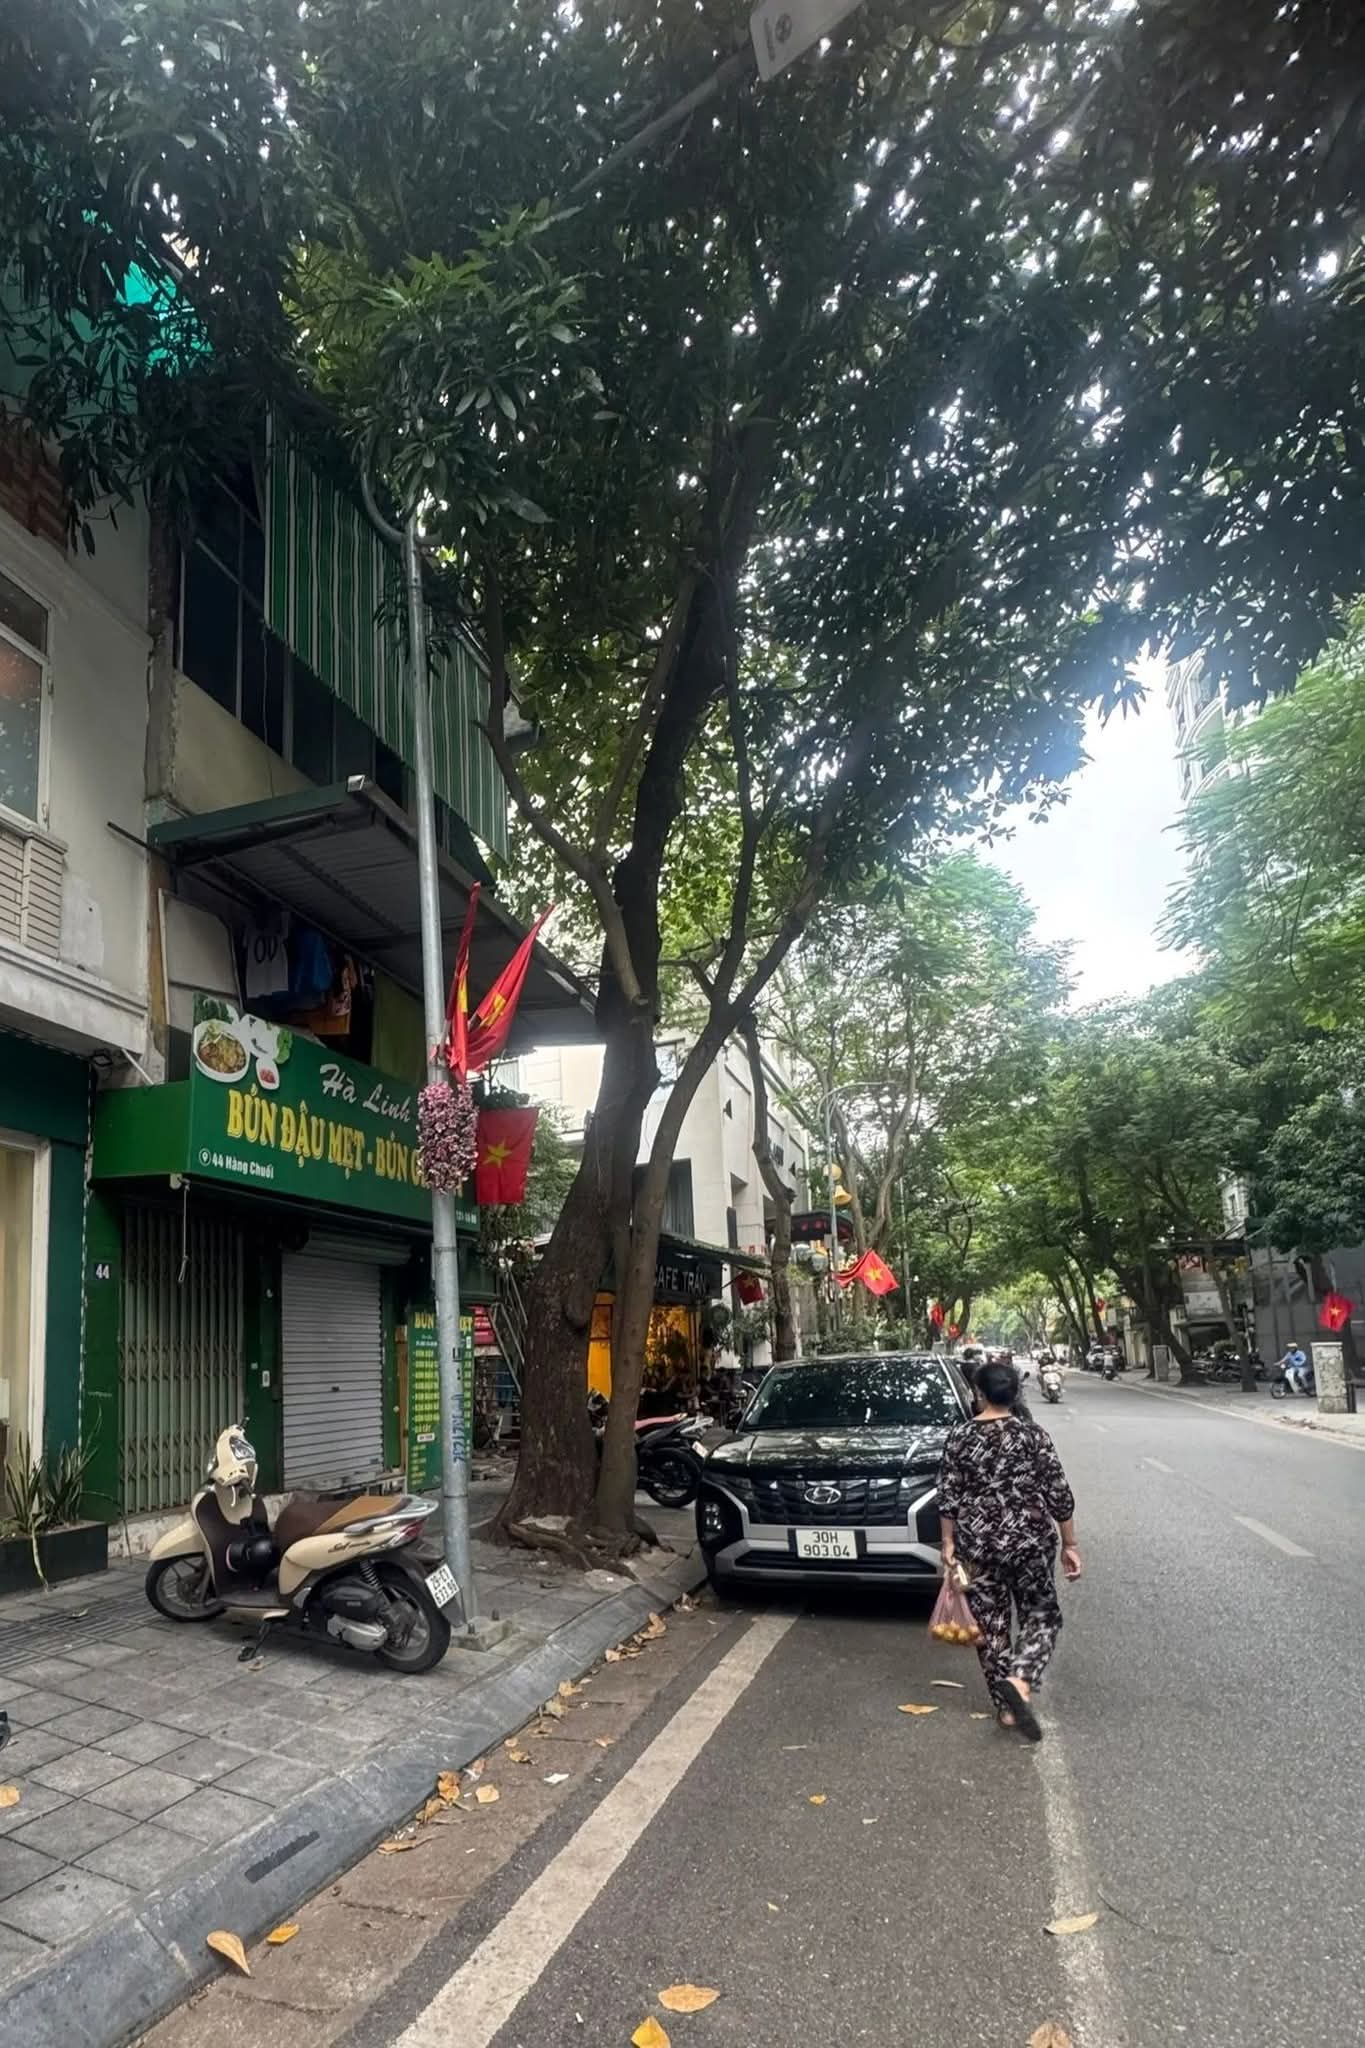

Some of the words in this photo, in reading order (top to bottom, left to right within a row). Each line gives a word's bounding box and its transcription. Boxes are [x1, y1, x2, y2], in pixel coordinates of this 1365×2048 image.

[320, 1063, 357, 1104] Hà
[362, 1083, 411, 1122] Linh
[227, 1083, 278, 1148] BÚN
[280, 1100, 326, 1168] ĐẬU
[328, 1121, 365, 1179] MẸT
[212, 1152, 224, 1168] 44
[225, 1154, 249, 1175] Hàng
[95, 1263, 110, 1279] 44
[812, 1531, 838, 1543] 30H
